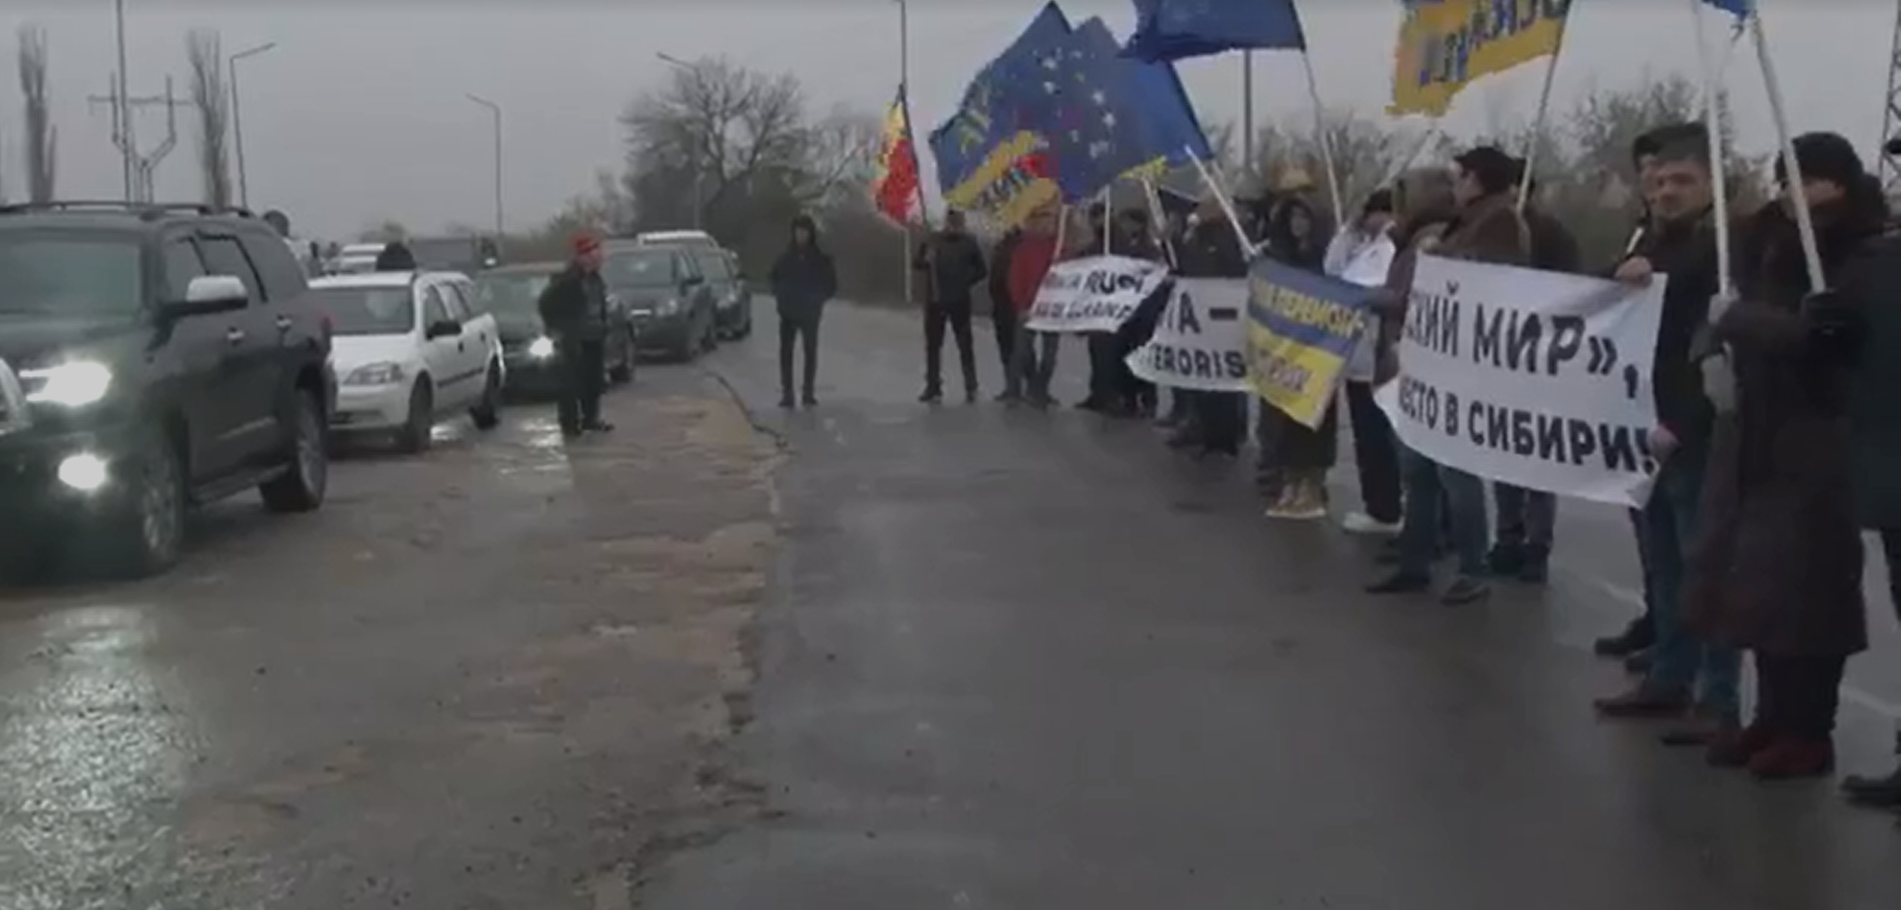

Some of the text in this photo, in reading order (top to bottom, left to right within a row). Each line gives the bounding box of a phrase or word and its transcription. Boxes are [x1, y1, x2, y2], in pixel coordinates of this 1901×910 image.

[1473, 303, 1639, 399] МИР»,
[1445, 391, 1459, 437] В
[1468, 401, 1655, 476] СИБИРИ!
